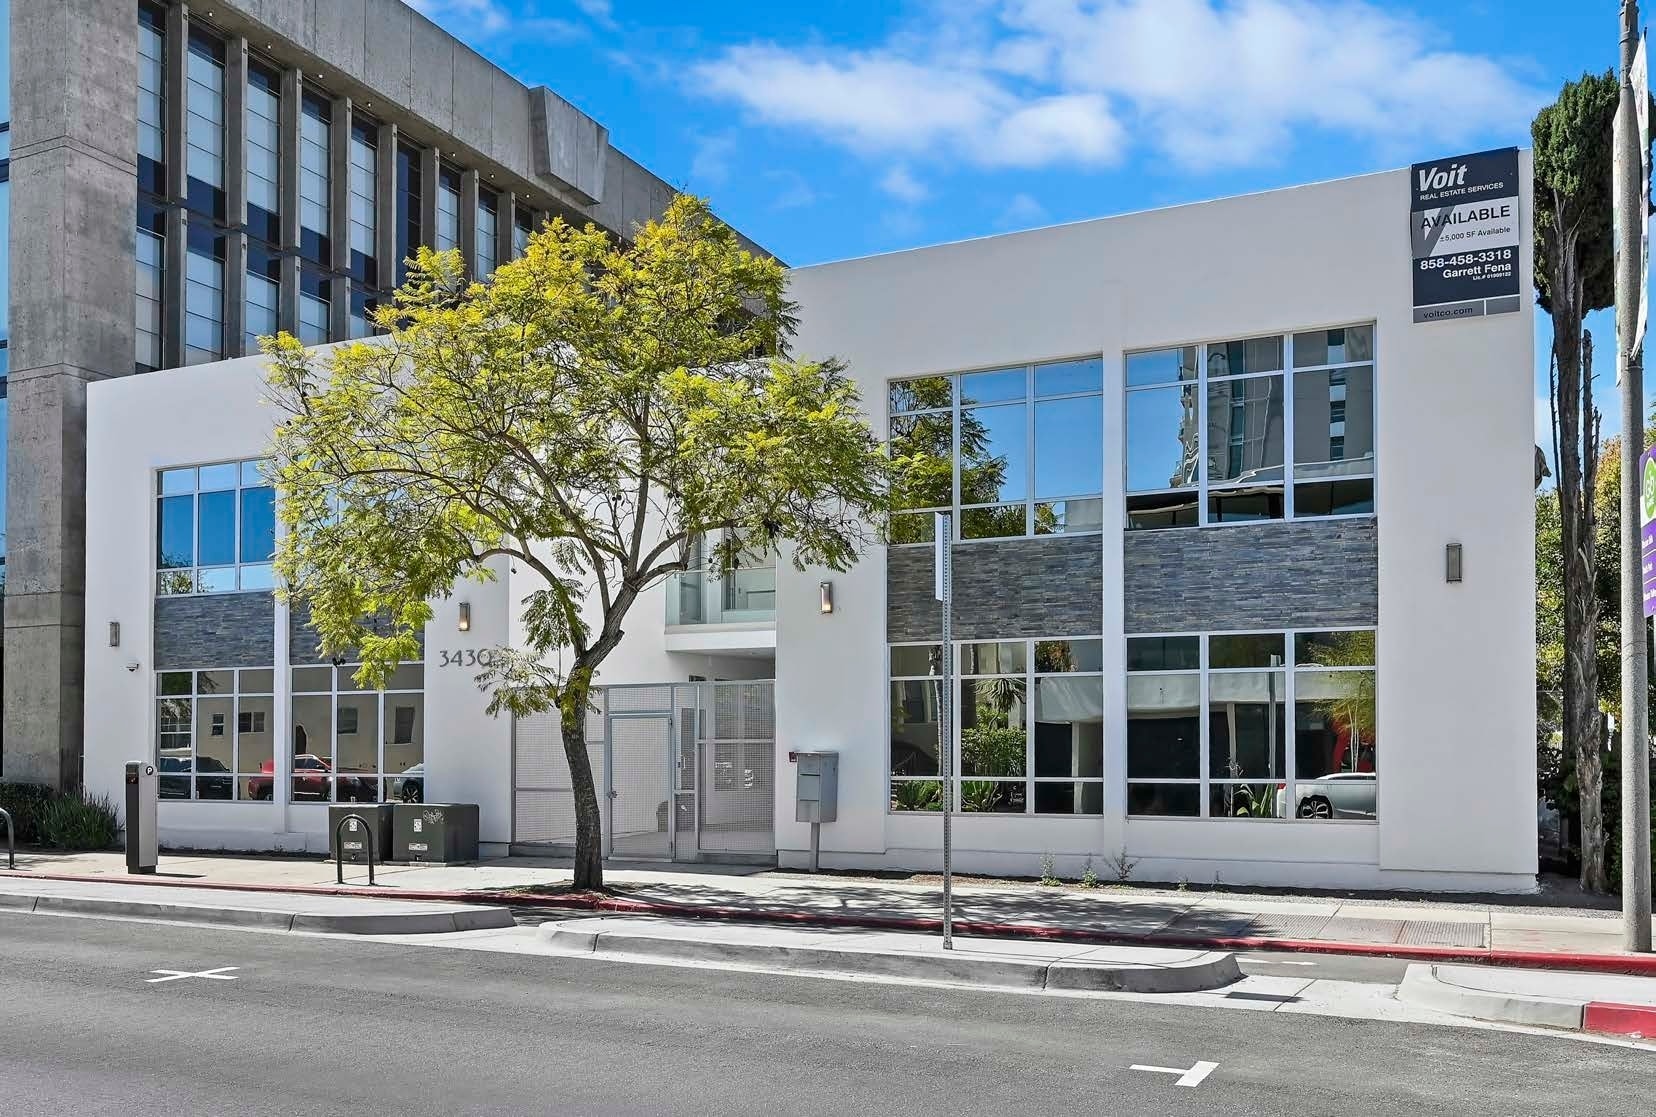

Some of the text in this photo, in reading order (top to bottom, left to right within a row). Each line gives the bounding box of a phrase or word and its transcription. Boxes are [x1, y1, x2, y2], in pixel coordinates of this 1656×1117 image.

[1418, 163, 1468, 192] Voit
[1419, 181, 1504, 201] REAL ESTATE SERVICES
[1420, 205, 1511, 230] AVAILABLE
[1466, 230, 1476, 239] SF
[1478, 226, 1511, 236] Available
[1420, 249, 1512, 270] 858-458-3318
[1442, 263, 1512, 279] Garrett Fena
[1423, 306, 1473, 319] voitco.com
[439, 648, 492, 668] 3430
